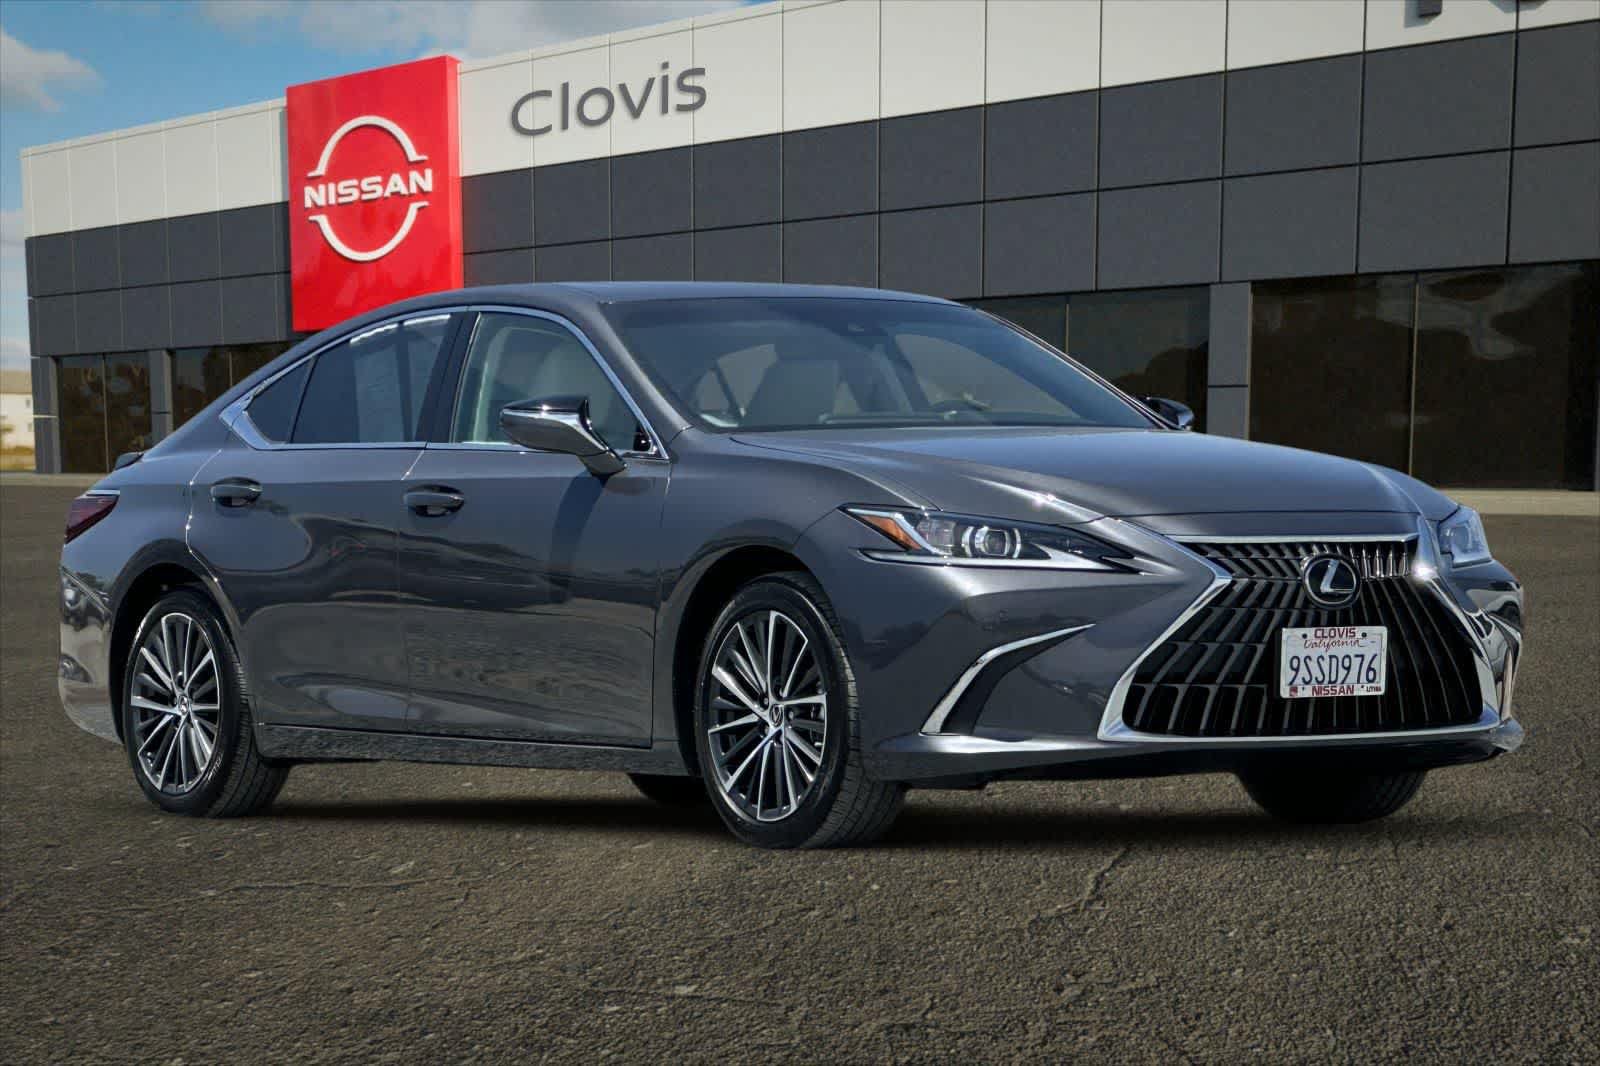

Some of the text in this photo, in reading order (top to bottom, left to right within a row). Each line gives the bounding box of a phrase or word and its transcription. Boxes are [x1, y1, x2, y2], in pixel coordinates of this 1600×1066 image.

[511, 62, 708, 137] Clovis
[304, 168, 433, 209] NISSAN
[1314, 627, 1356, 639] CLOVIS
[1303, 638, 1363, 652] California
[1288, 653, 1378, 686] 9SSD976
[1311, 685, 1355, 697] NISSAN
